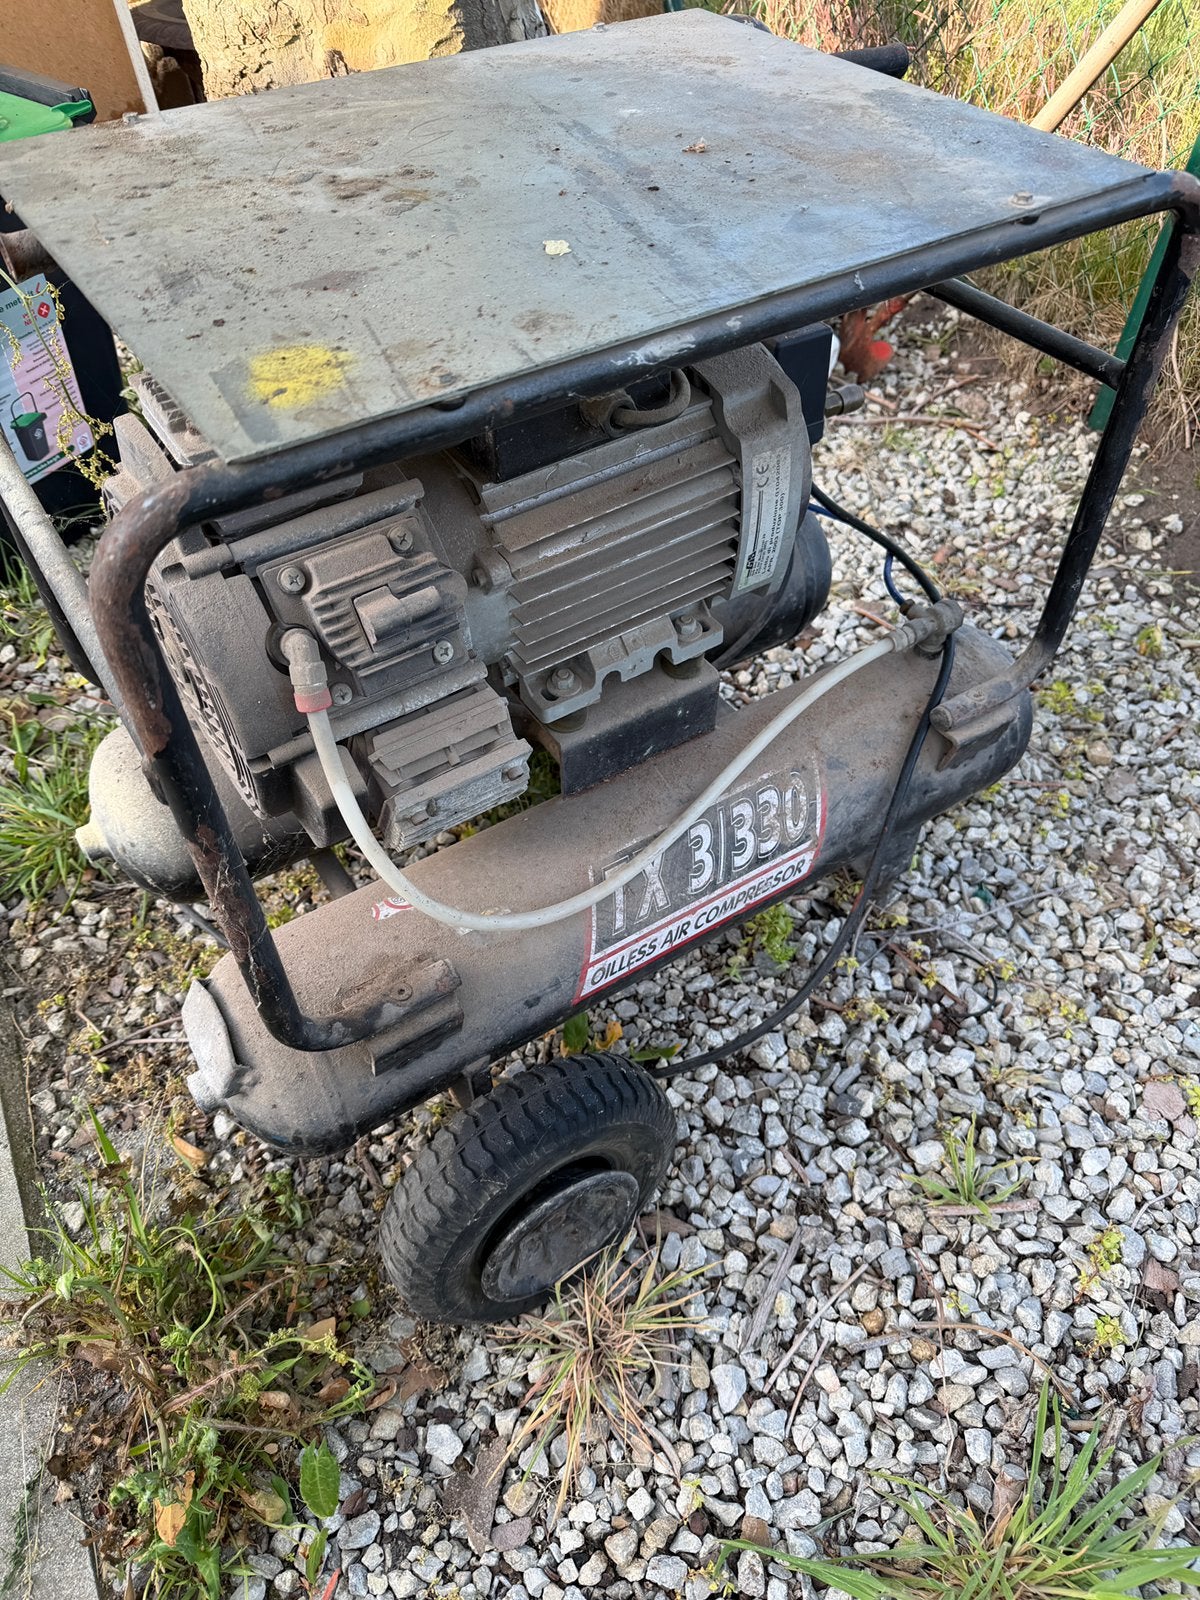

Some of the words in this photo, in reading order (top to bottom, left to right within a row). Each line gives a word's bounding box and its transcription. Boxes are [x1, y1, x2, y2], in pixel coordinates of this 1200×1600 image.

[5, 297, 21, 310] met
[769, 499, 779, 545] produzione
[602, 848, 671, 935] TX
[688, 772, 809, 895] 3/330
[590, 936, 657, 986] OILLESS
[660, 917, 690, 949] AIR
[693, 858, 806, 931] COMPRESSOR
